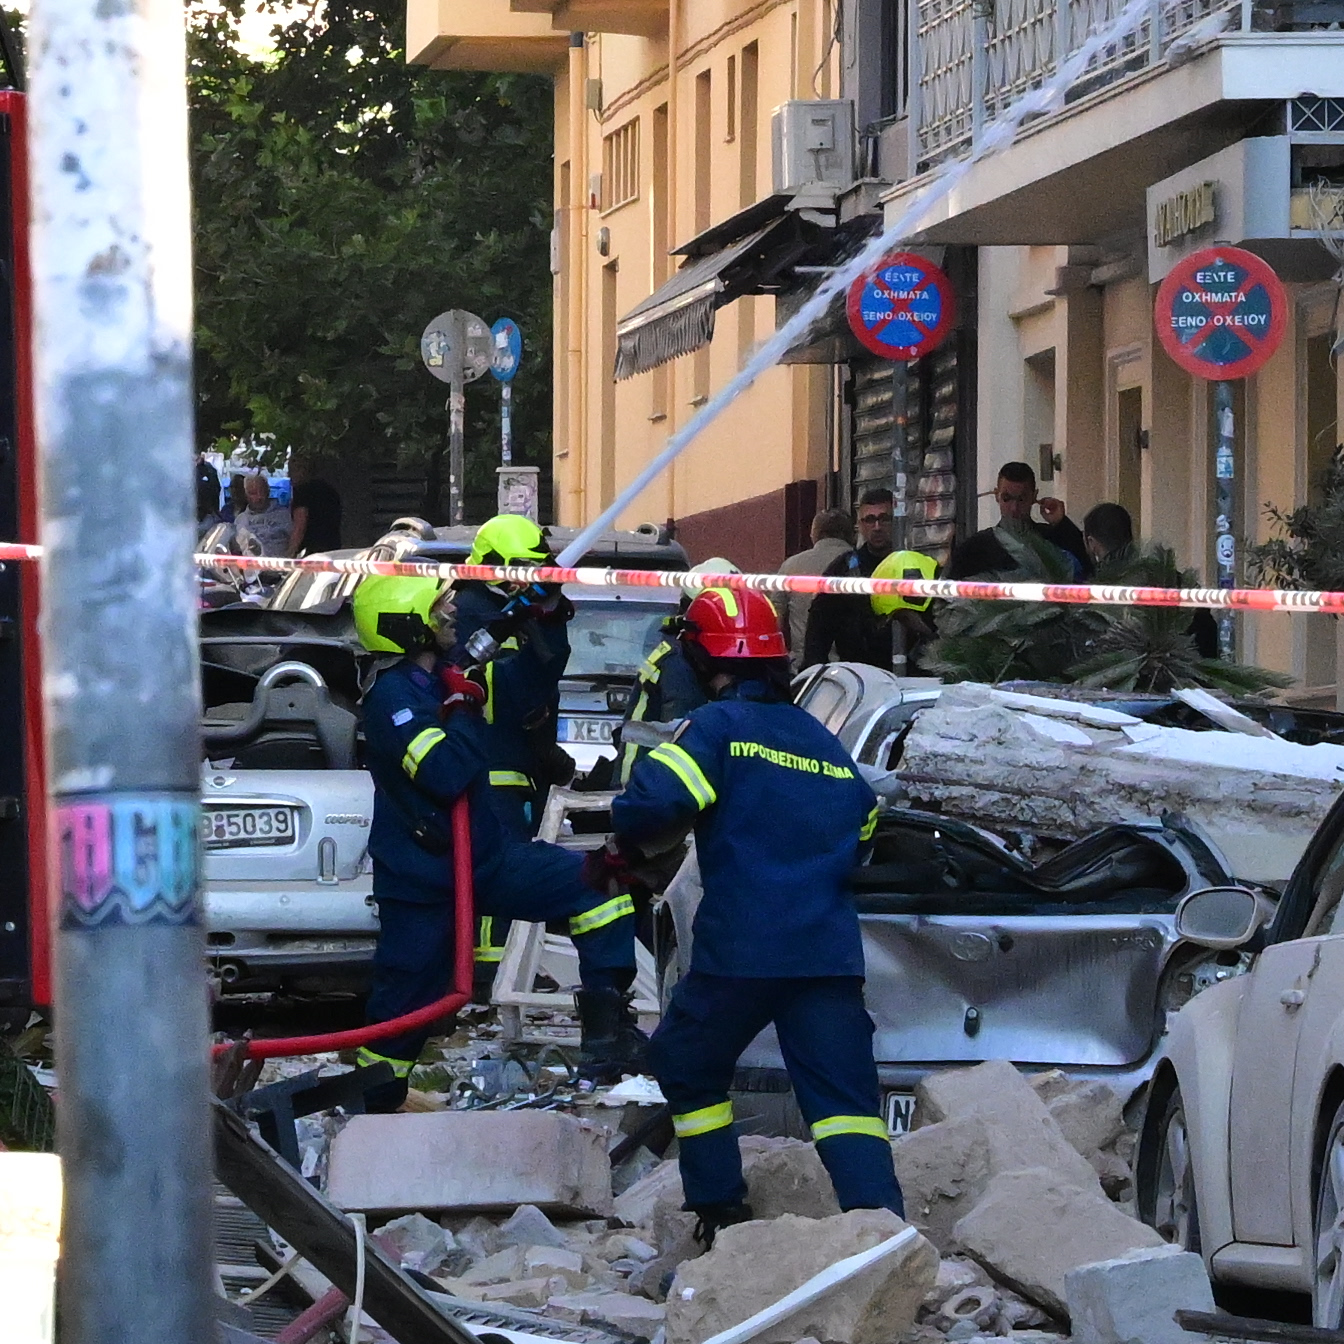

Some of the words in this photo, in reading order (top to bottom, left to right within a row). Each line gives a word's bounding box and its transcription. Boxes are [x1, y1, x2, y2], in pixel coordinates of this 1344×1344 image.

[873, 289, 930, 301] ΟΧΗΜΑΤΑ
[1182, 291, 1247, 303] ΟΧΗΜΑΤΑ
[862, 311, 938, 323] ΞΕΝΟΟΧΕΙΟΥ
[1171, 314, 1267, 328] ΞΕΝΟΟΧΕΙΟΥ
[730, 741, 820, 774] ΠΥΡΟΣΒΕΣΤΙΚΟ
[822, 760, 855, 779] ΣΩΜΑ
[226, 810, 288, 837] 5039
